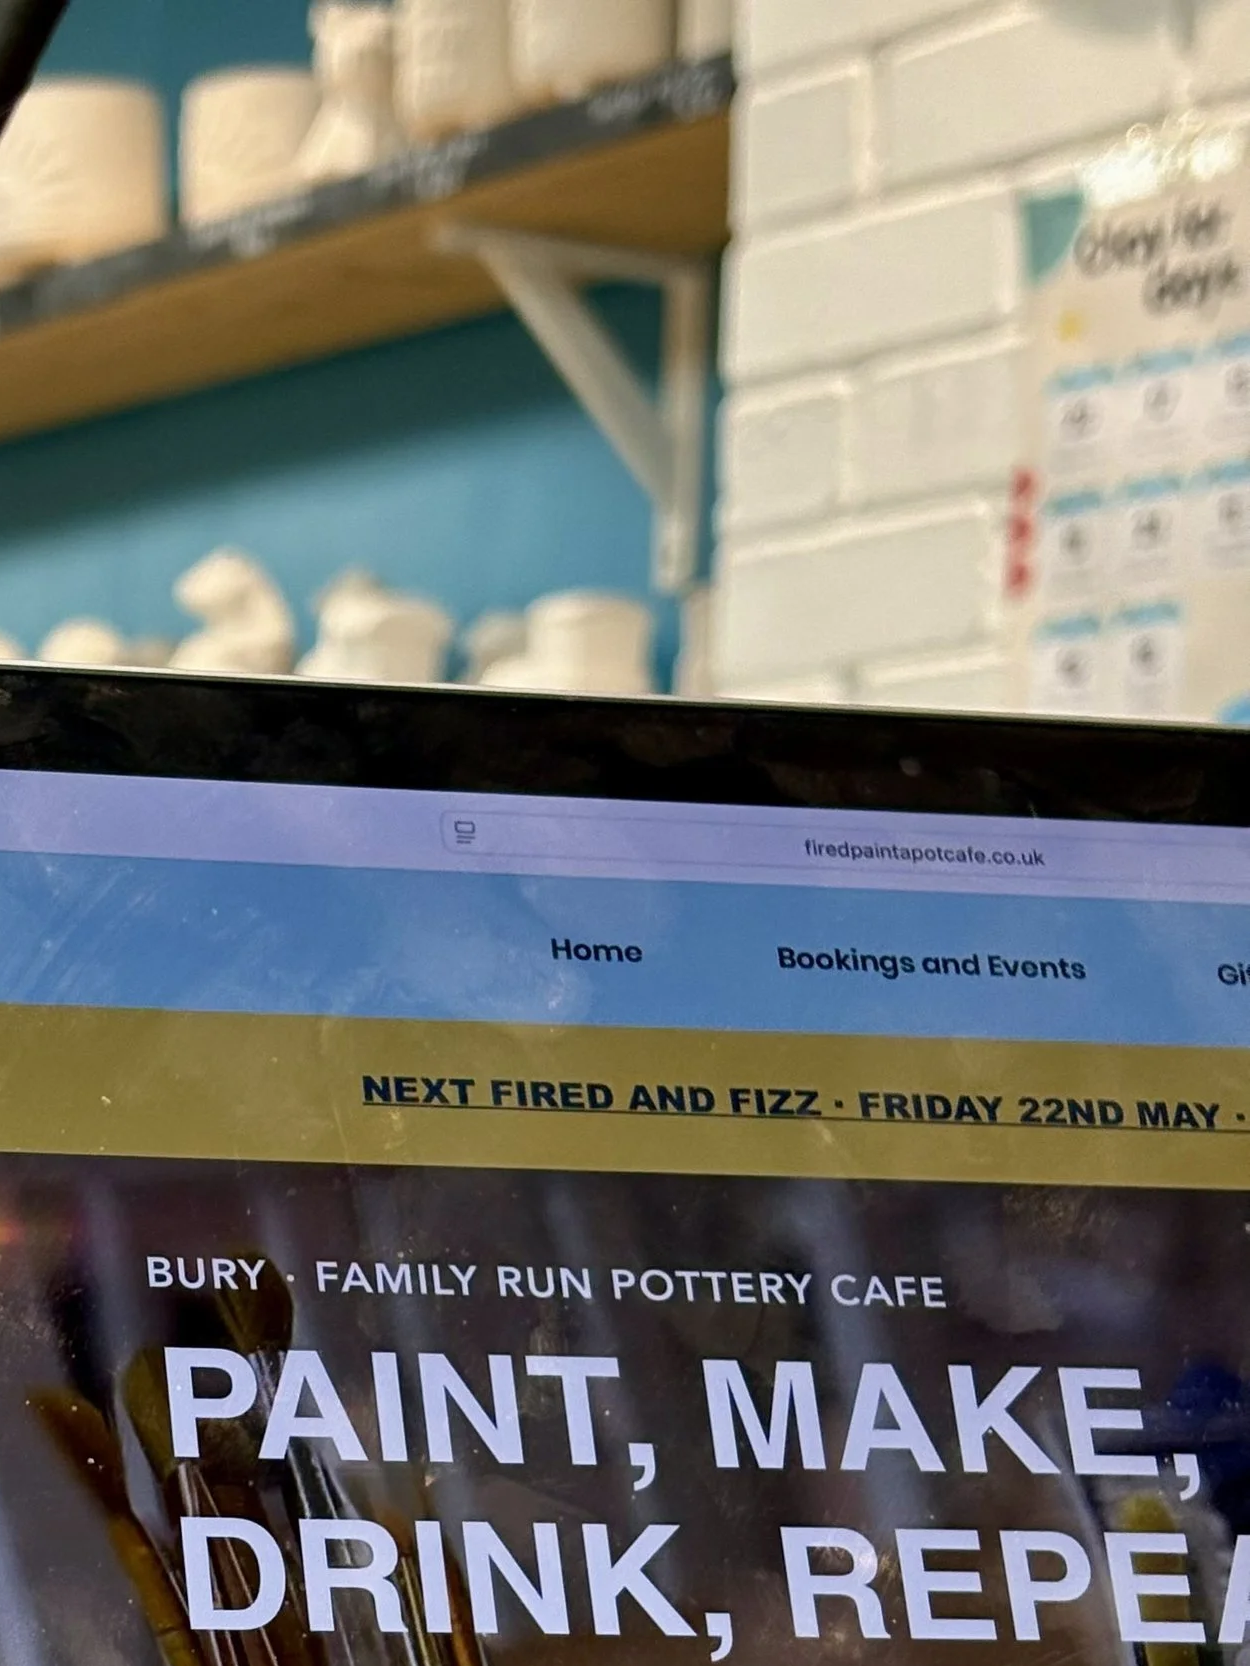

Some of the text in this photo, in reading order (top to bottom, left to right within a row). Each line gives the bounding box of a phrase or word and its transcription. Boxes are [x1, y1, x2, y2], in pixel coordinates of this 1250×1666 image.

[804, 838, 1046, 867] firedpaintapotcafe.co.uk
[551, 938, 642, 964] Home
[777, 946, 1086, 981] Bookings and Events
[362, 1074, 475, 1107] NEXT
[490, 1078, 614, 1112] FIRED
[628, 1082, 715, 1114] AND
[730, 1087, 821, 1118] FIZZ
[859, 1090, 1003, 1124] FRIDAY
[1018, 1096, 1124, 1128] 22ND
[1137, 1100, 1220, 1130] MAY
[147, 1256, 265, 1290] BURY
[316, 1260, 477, 1296] FAMILY
[497, 1266, 593, 1300] RUN
[612, 1268, 813, 1305] POTTERY
[830, 1273, 948, 1309] CAFE
[163, 1346, 1200, 1502] PAINT, MAKE,
[180, 1516, 736, 1662] DRINK,
